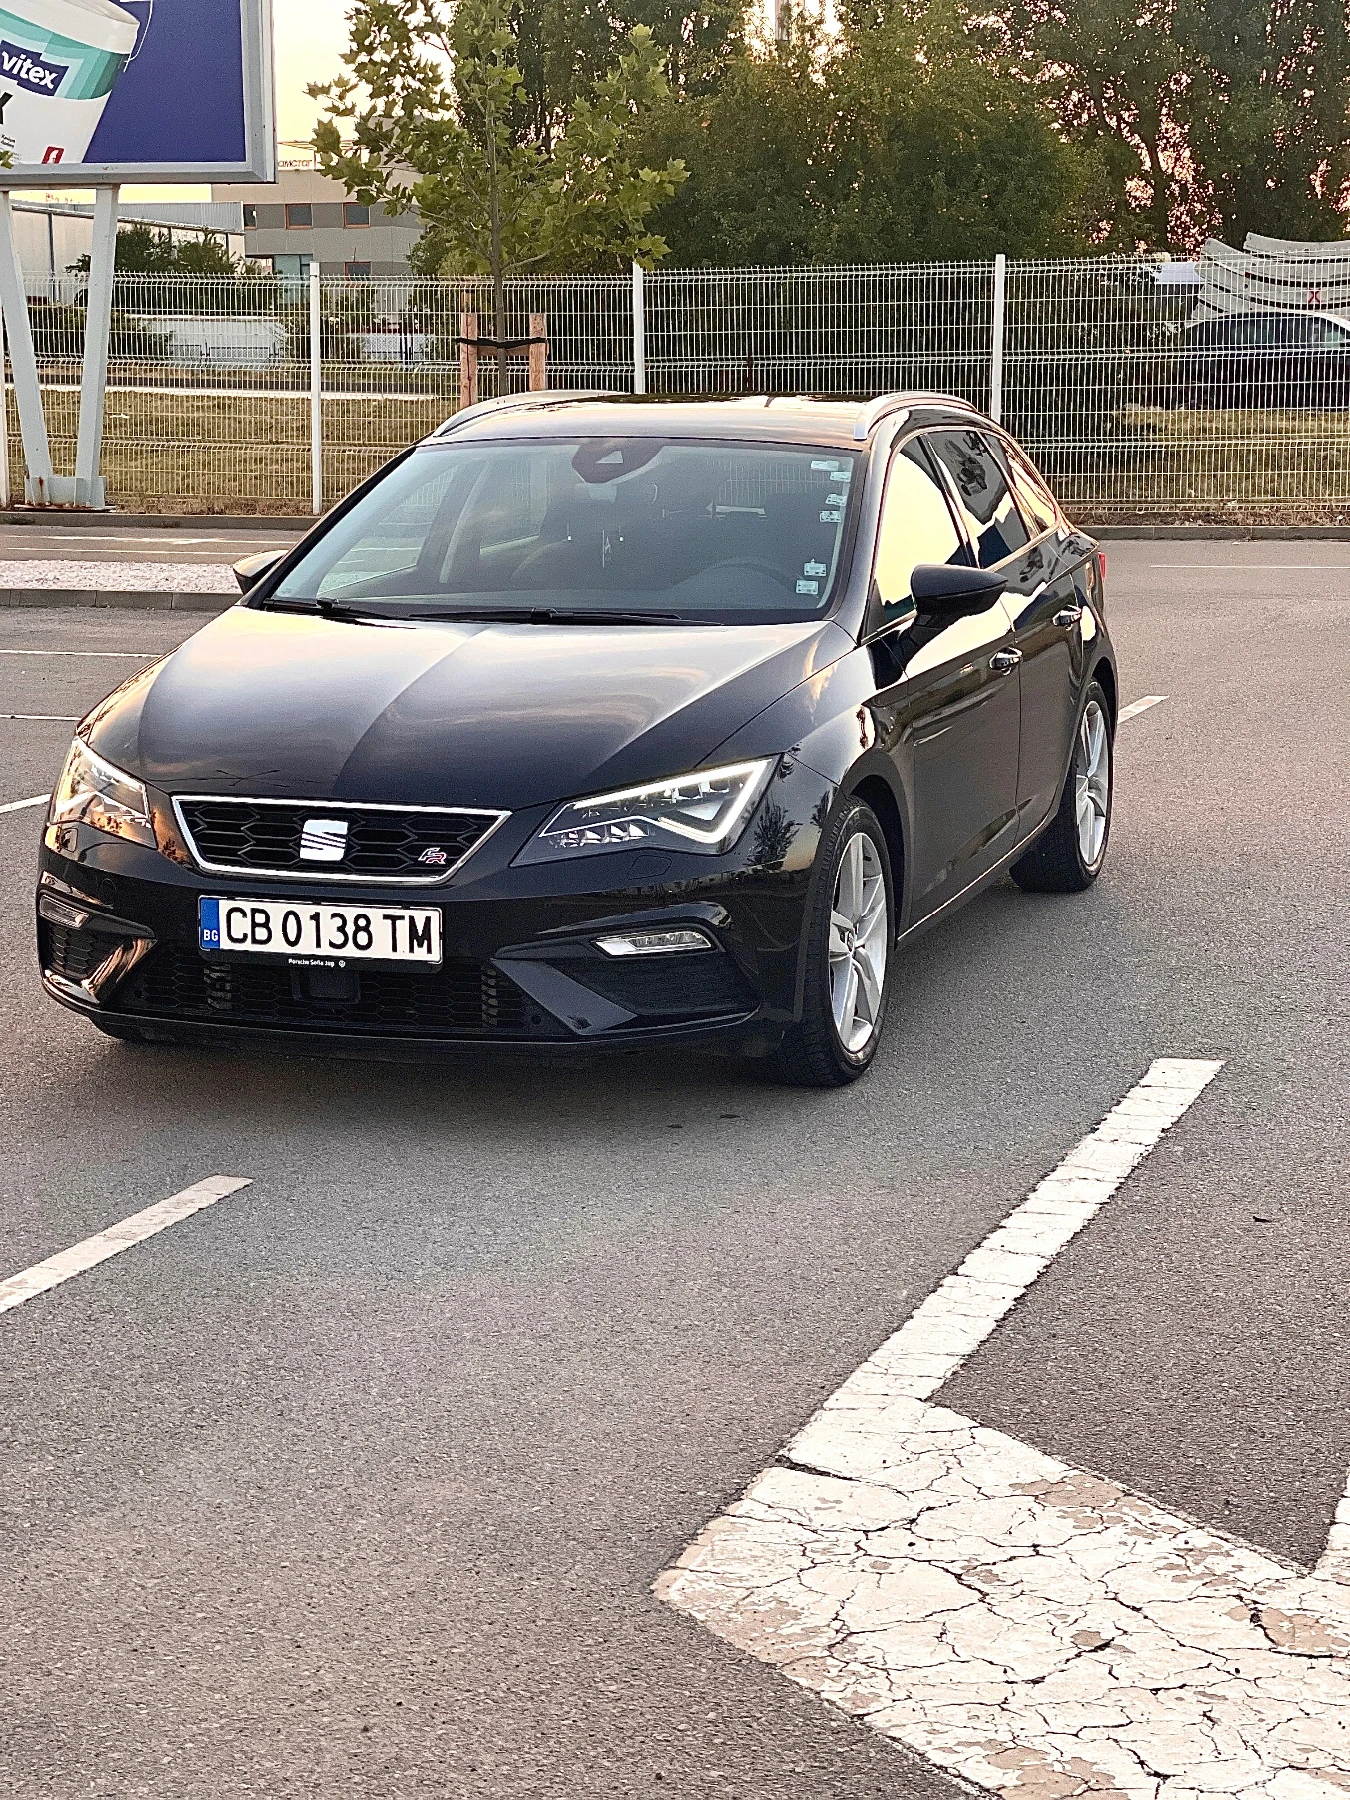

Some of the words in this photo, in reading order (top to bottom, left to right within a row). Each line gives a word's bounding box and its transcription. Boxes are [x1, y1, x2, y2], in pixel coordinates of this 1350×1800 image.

[1, 50, 58, 90] vitex
[203, 929, 219, 942] BG
[225, 906, 273, 945] CB
[281, 909, 374, 951] 0138
[382, 914, 433, 955] TM
